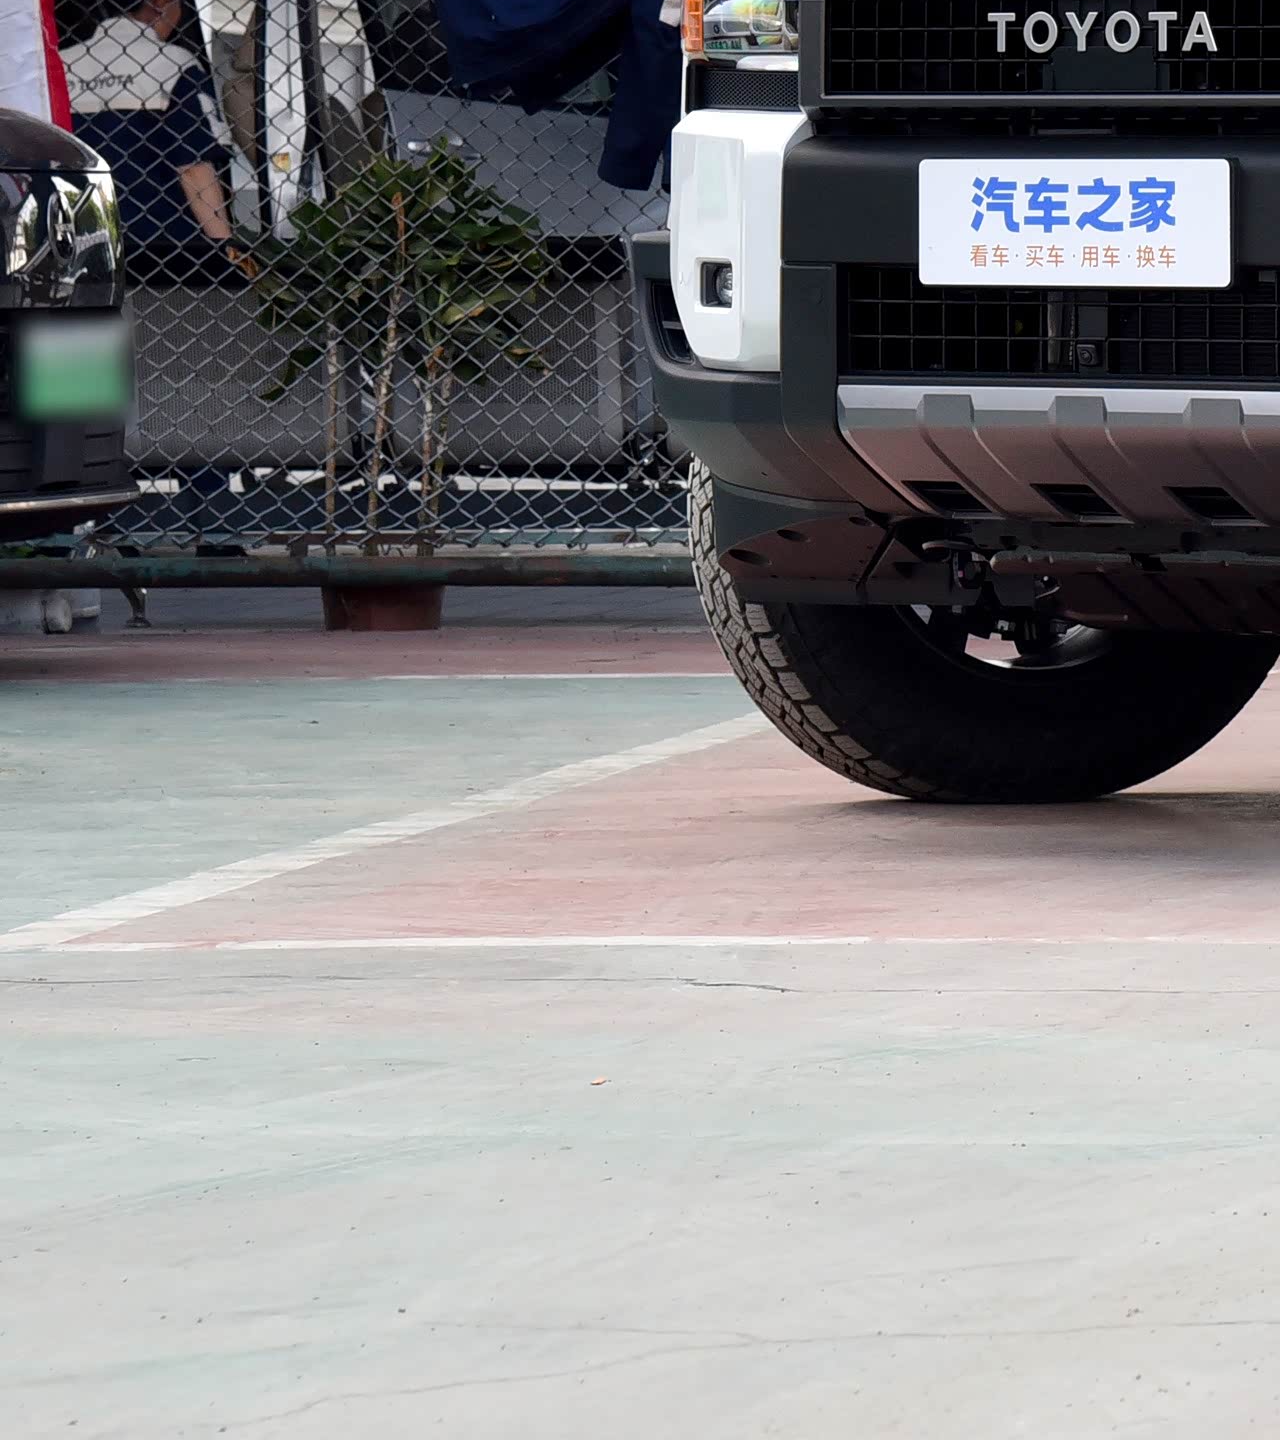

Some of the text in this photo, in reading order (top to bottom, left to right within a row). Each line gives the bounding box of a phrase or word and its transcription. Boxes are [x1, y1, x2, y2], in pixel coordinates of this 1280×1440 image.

[987, 11, 1218, 53] TOYOTA
[970, 176, 1176, 233] 汽车之家
